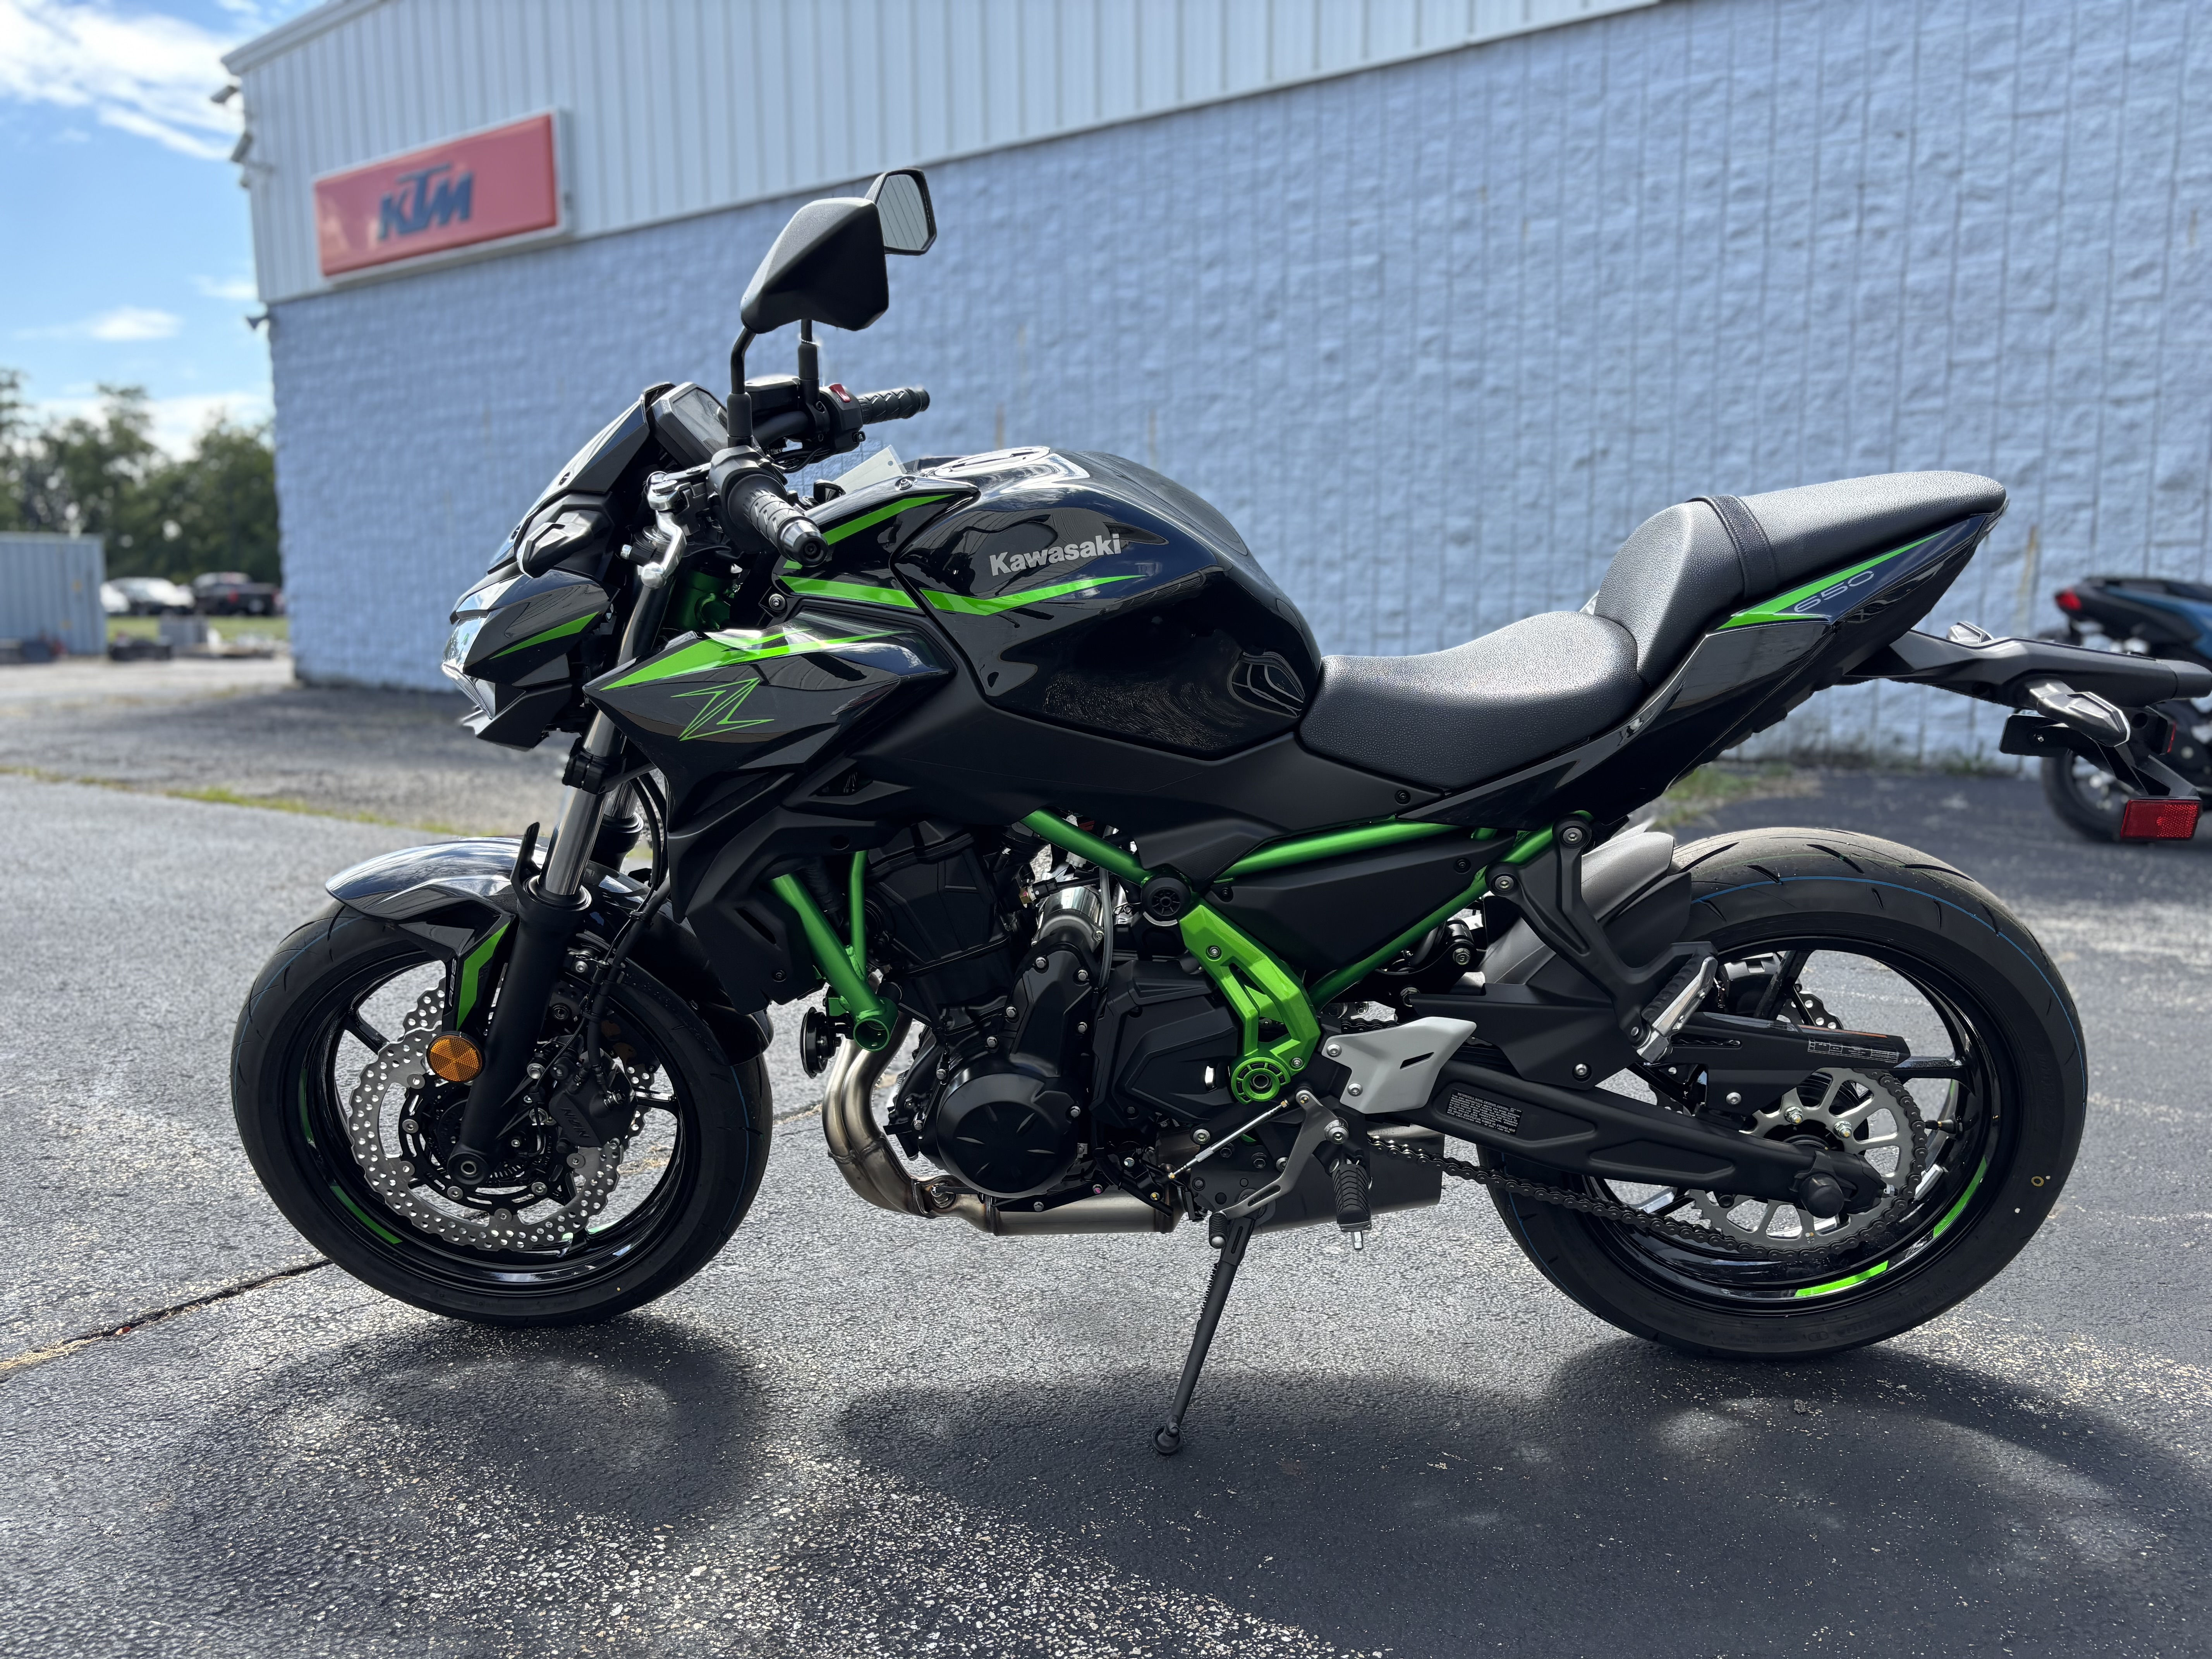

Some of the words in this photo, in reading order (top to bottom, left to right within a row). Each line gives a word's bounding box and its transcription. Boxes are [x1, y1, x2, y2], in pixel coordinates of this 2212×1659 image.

[378, 163, 474, 240] KTM
[990, 534, 1121, 576] Kawasaki
[1794, 571, 1875, 613] 650
[448, 958, 457, 1007] ABS
